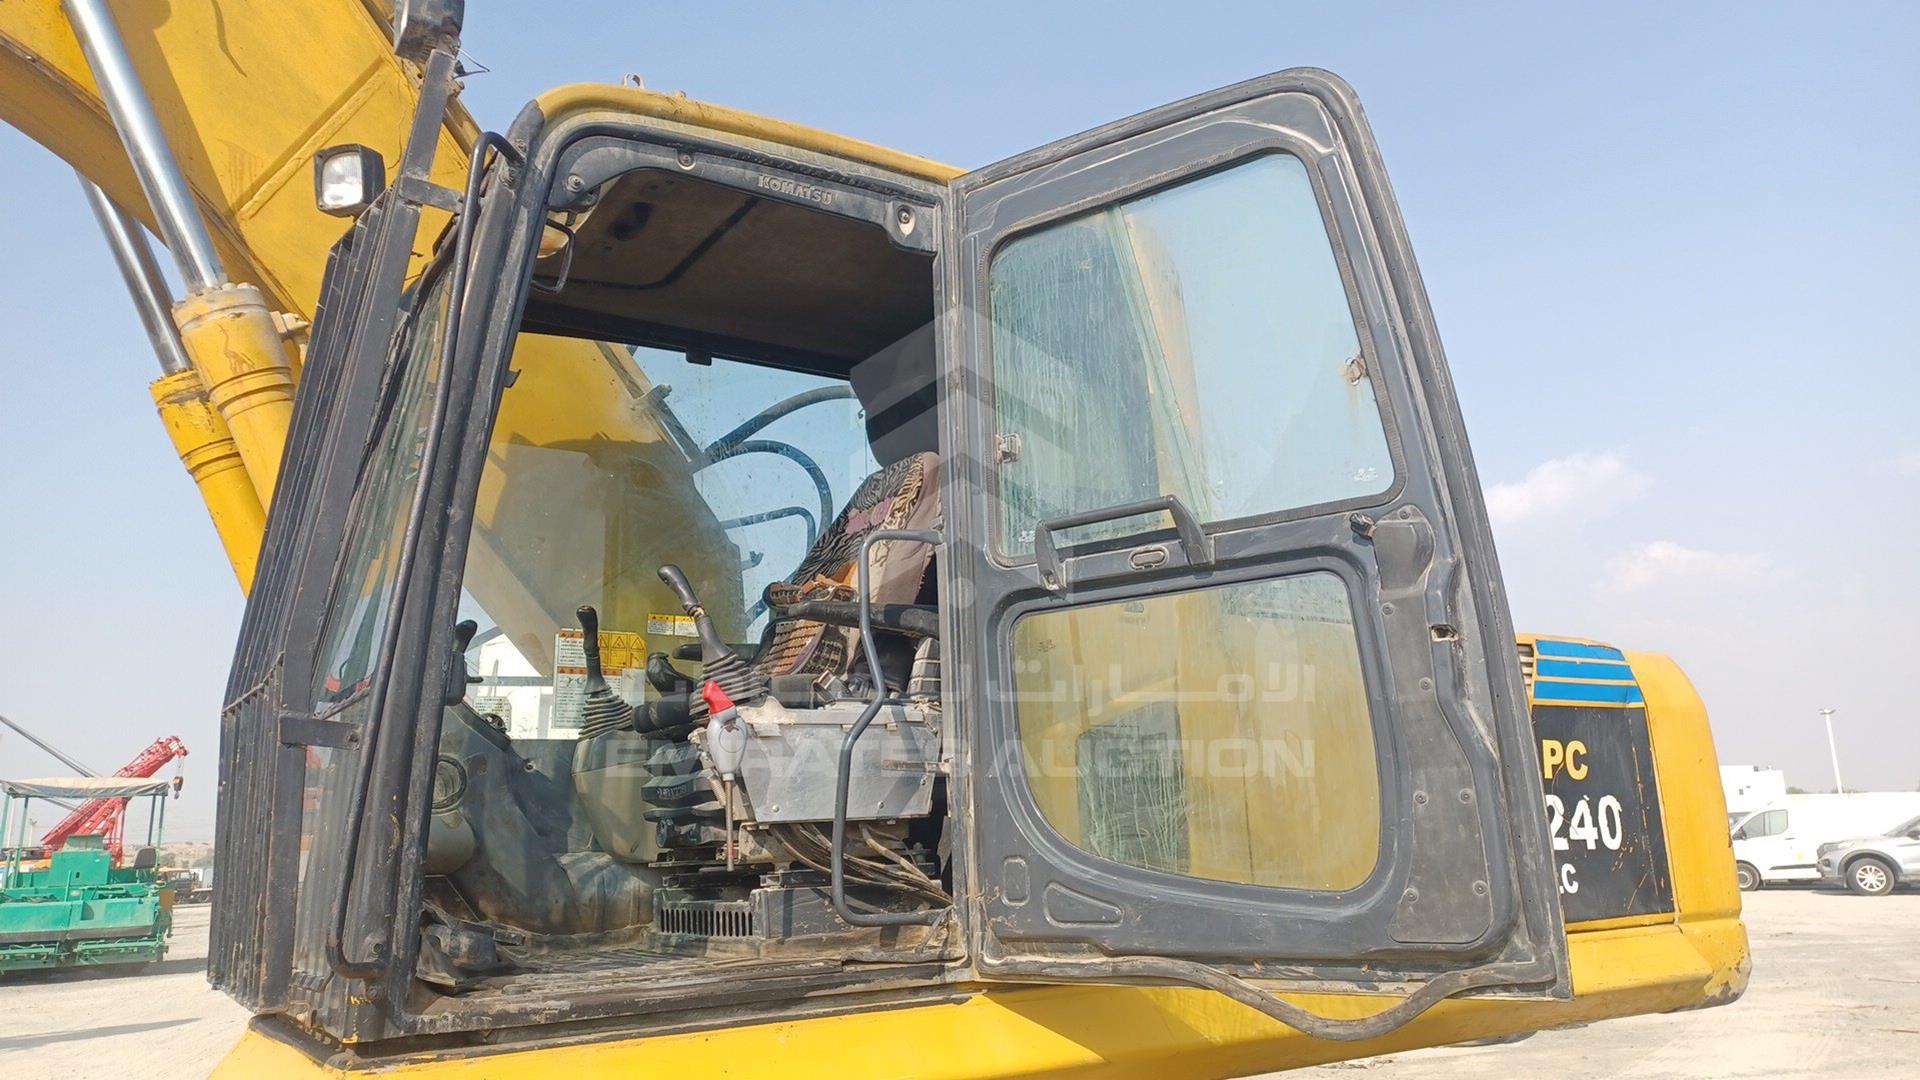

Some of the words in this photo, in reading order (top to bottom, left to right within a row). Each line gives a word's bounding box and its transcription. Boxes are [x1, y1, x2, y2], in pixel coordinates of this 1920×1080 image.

[757, 174, 833, 205] KOMATSU
[1542, 739, 1589, 781] PC
[1545, 794, 1623, 851] 240
[1560, 863, 1580, 894] C
